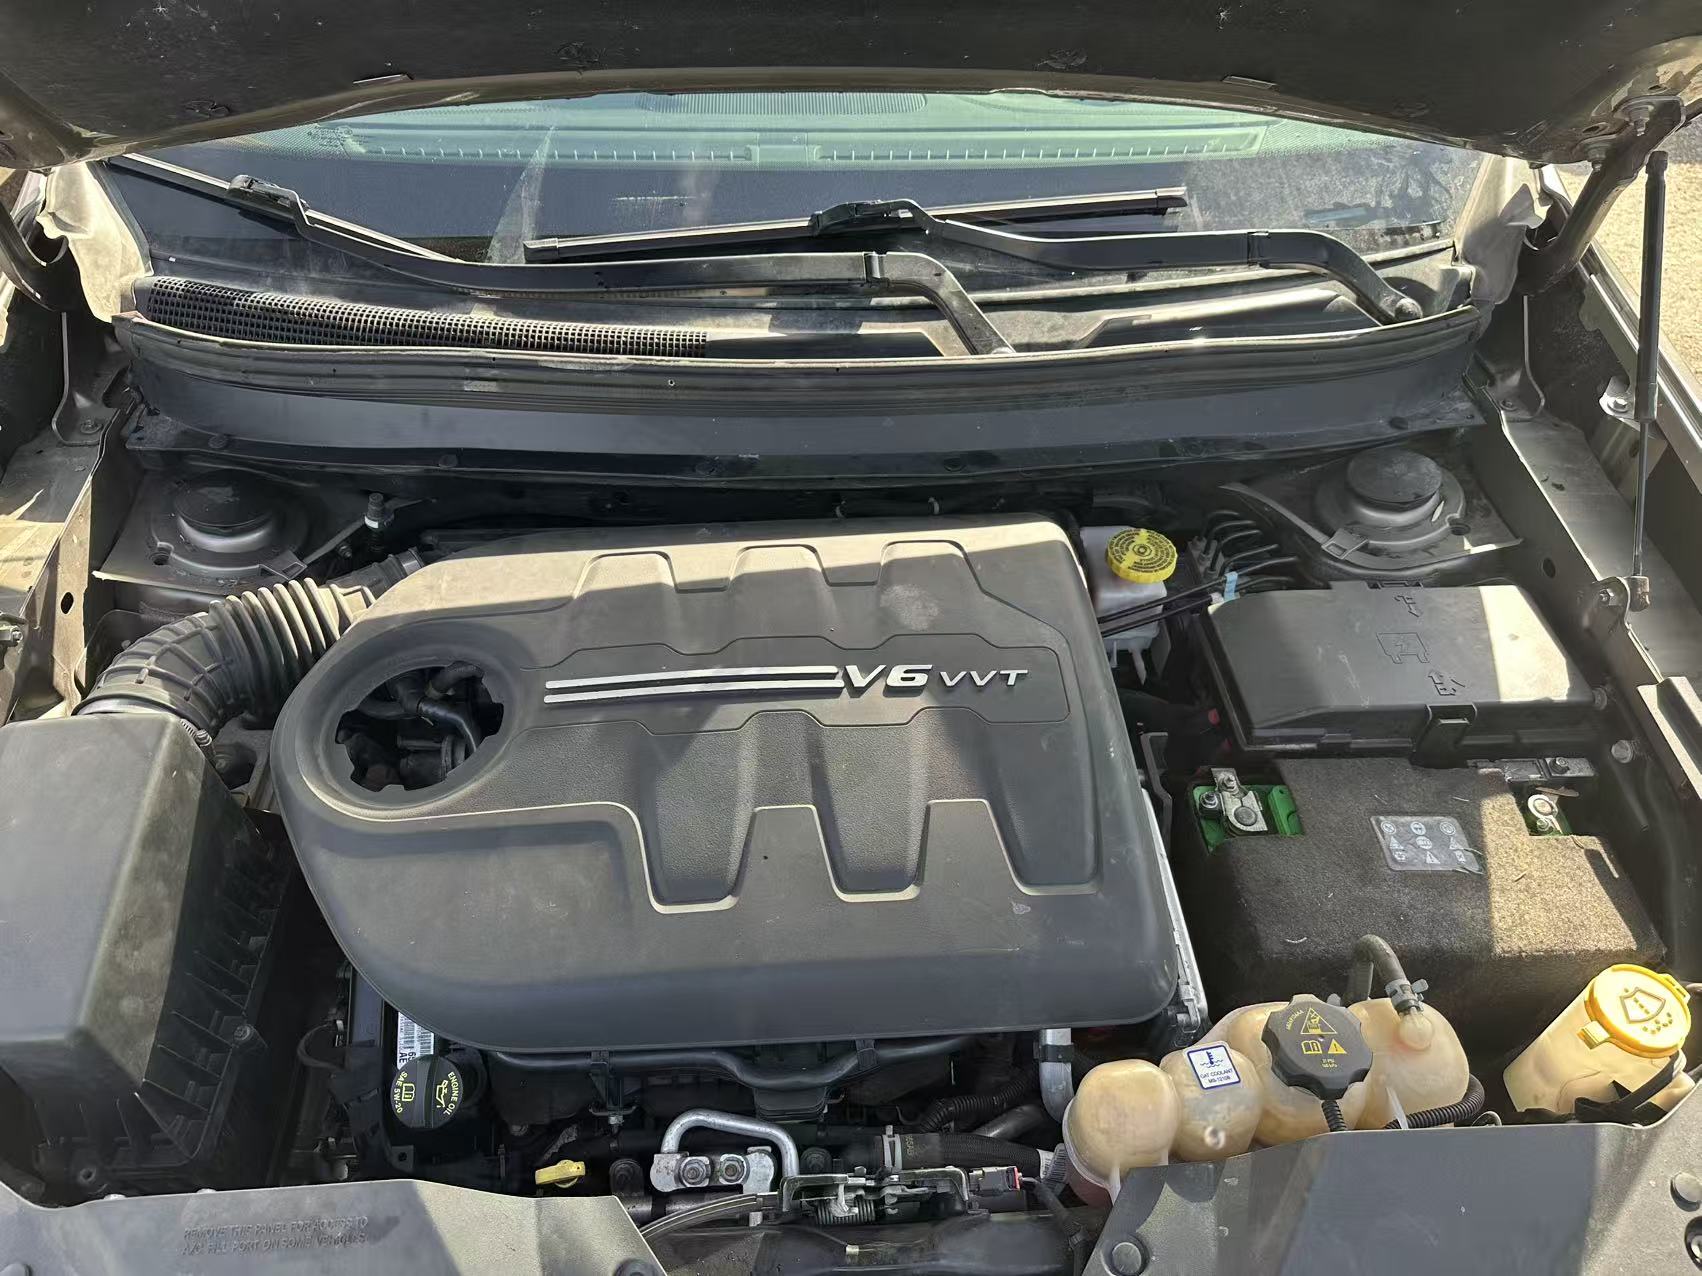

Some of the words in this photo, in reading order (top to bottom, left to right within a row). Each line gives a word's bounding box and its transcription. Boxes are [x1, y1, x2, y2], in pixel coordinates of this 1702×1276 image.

[845, 664, 933, 688] V6
[939, 669, 1029, 687] VVT
[395, 1071, 408, 1087] SAE
[447, 1071, 458, 1102] ENGINE
[393, 1088, 403, 1114] 5W-20
[443, 1103, 455, 1115] OIL
